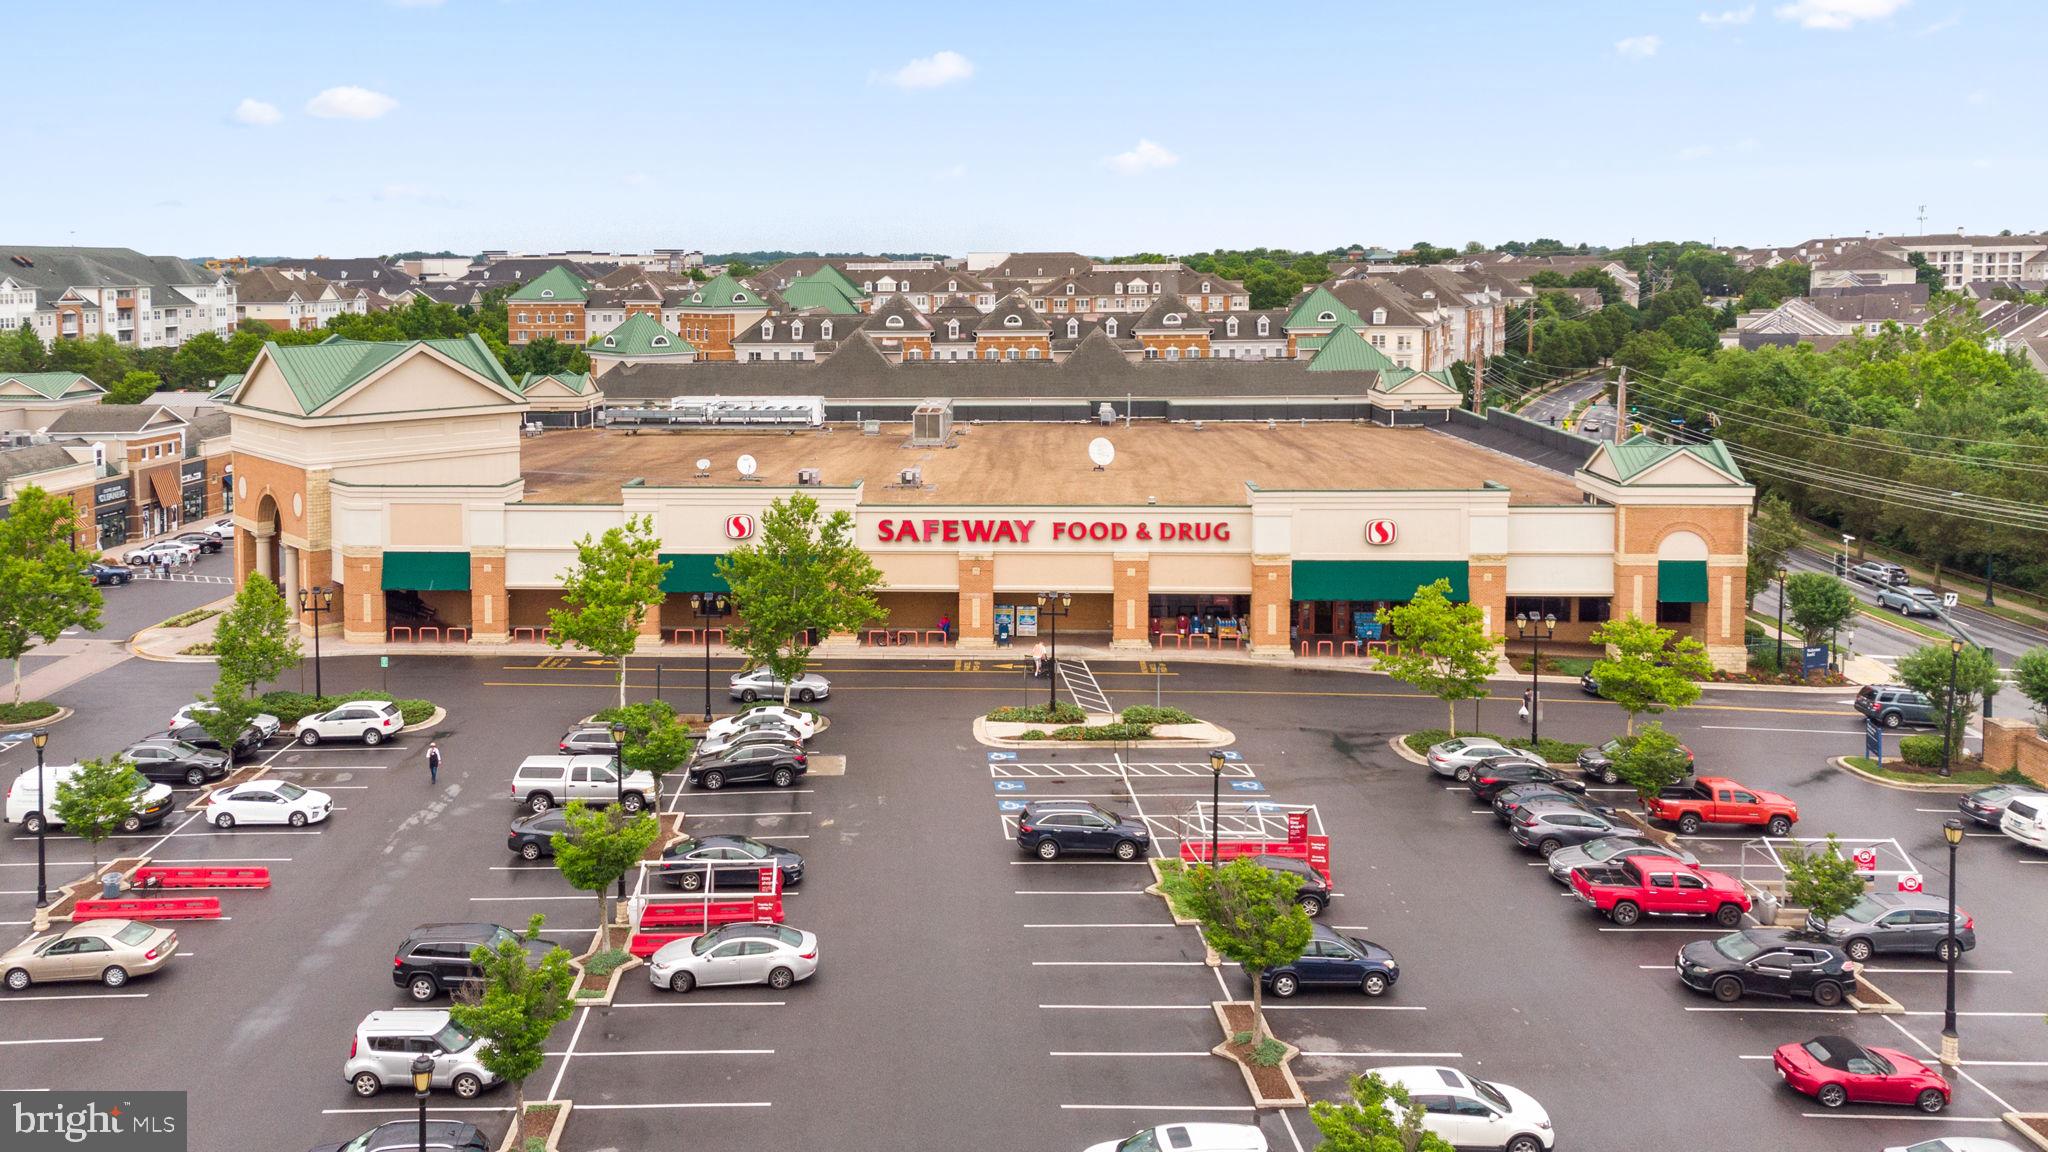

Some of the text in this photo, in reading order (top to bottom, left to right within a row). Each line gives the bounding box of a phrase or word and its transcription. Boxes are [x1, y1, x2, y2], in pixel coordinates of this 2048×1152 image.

[878, 519, 1231, 542] SAFEWAY FOOD & DRUG
